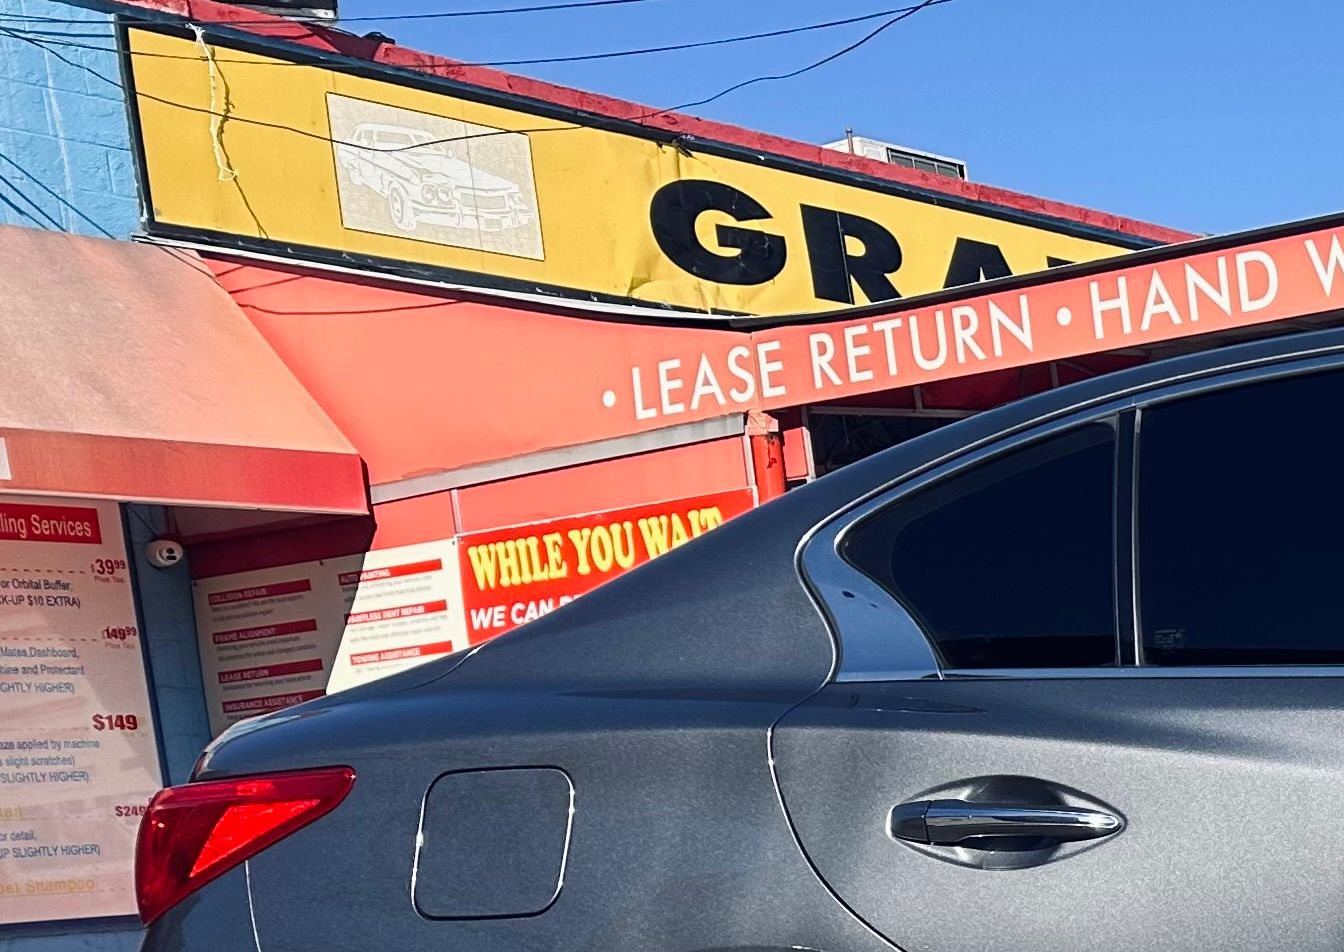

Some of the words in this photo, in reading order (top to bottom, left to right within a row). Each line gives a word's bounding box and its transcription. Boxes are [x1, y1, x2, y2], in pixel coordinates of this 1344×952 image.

[649, 178, 1078, 306] GRA
[631, 340, 786, 421] LEASE
[808, 293, 1036, 390] RETURN
[1089, 249, 1279, 340] HAND
[31, 513, 93, 538] Services
[467, 531, 569, 592] WHILE
[567, 520, 636, 575] YOU
[12, 578, 42, 590] Orbital
[27, 595, 45, 607] $10
[46, 595, 81, 609] EXTRA)
[470, 609, 506, 631] WE
[510, 598, 555, 625] CAN
[22, 664, 39, 675] and
[34, 682, 75, 694] HIGHER)
[92, 712, 138, 731] $149
[17, 739, 49, 751] applied
[50, 740, 62, 751] by
[49, 770, 90, 784] HIGHER)
[13, 846, 59, 859] SLIGHTLY
[60, 844, 101, 857] HIGHER)
[24, 878, 96, 894] Shampoo
